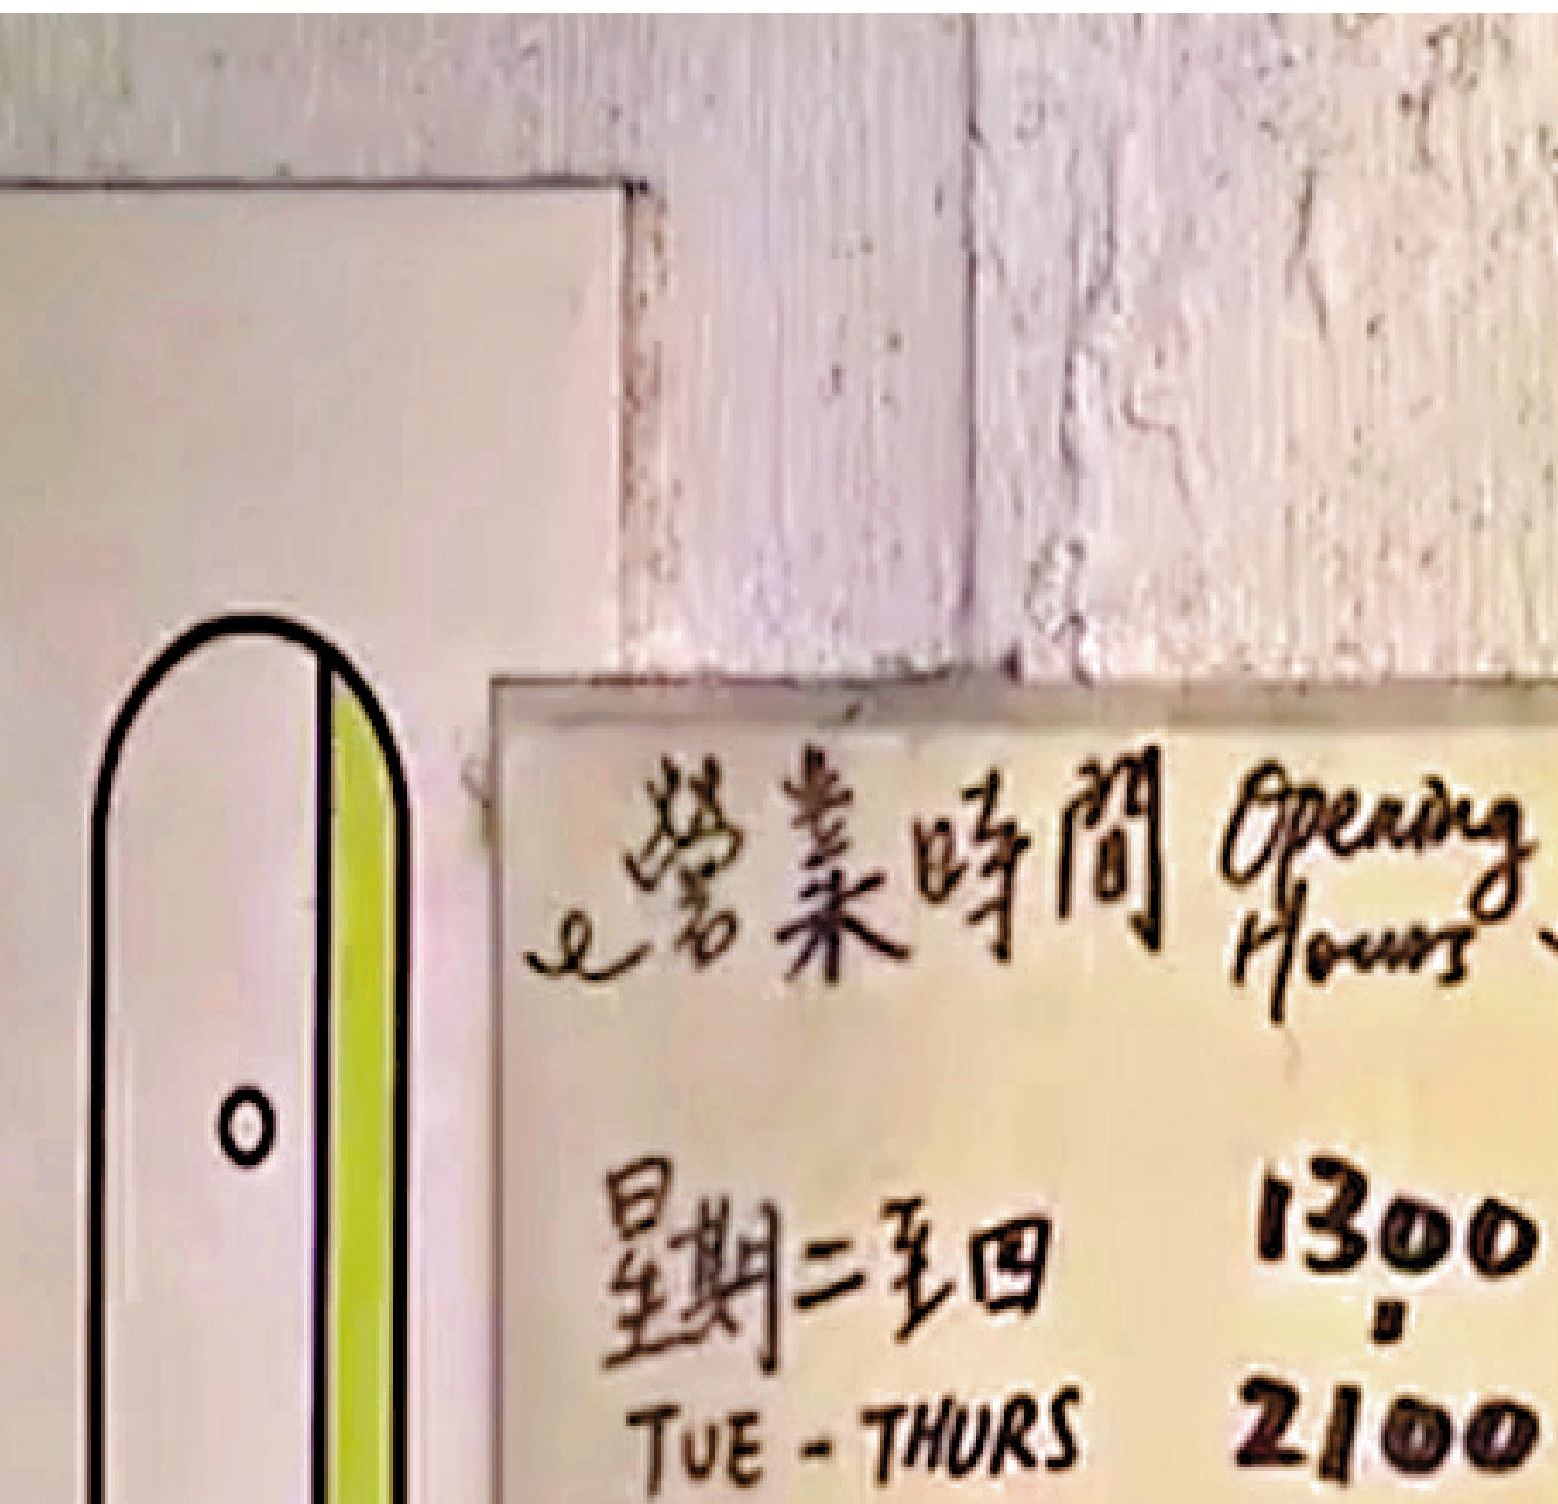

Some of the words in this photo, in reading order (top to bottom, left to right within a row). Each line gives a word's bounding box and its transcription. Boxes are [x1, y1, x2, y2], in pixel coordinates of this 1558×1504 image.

[625, 743, 1161, 987] 營業時間
[1220, 760, 1536, 922] Opening
[1230, 882, 1477, 1024] Hours
[602, 1155, 1052, 1375] 星期二至四
[1258, 1155, 1539, 1278] 1300
[626, 1405, 763, 1498] TUE
[860, 1385, 1079, 1484] THURS
[1234, 1375, 1539, 1484] 2100
